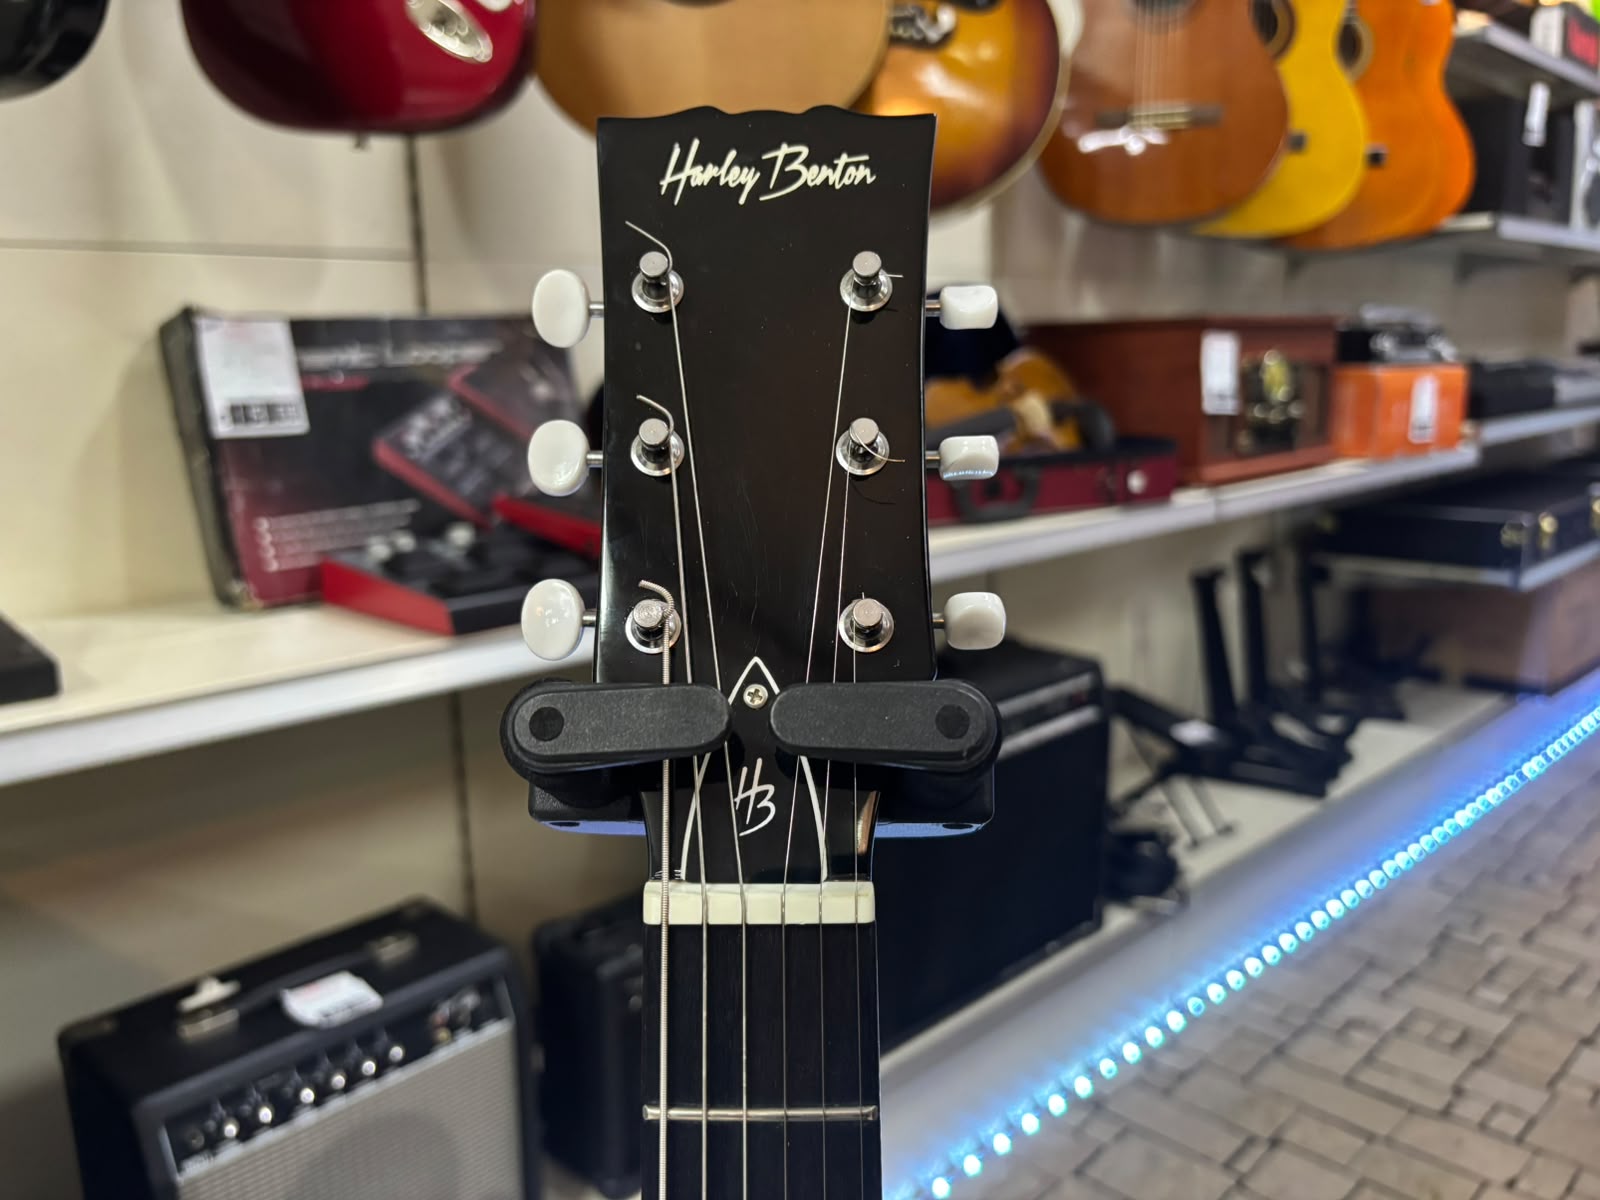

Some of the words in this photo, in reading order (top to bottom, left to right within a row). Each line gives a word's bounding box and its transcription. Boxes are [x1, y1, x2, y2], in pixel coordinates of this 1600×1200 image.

[660, 138, 760, 205] Harley
[759, 142, 876, 201] Benton
[733, 757, 776, 836] HB
